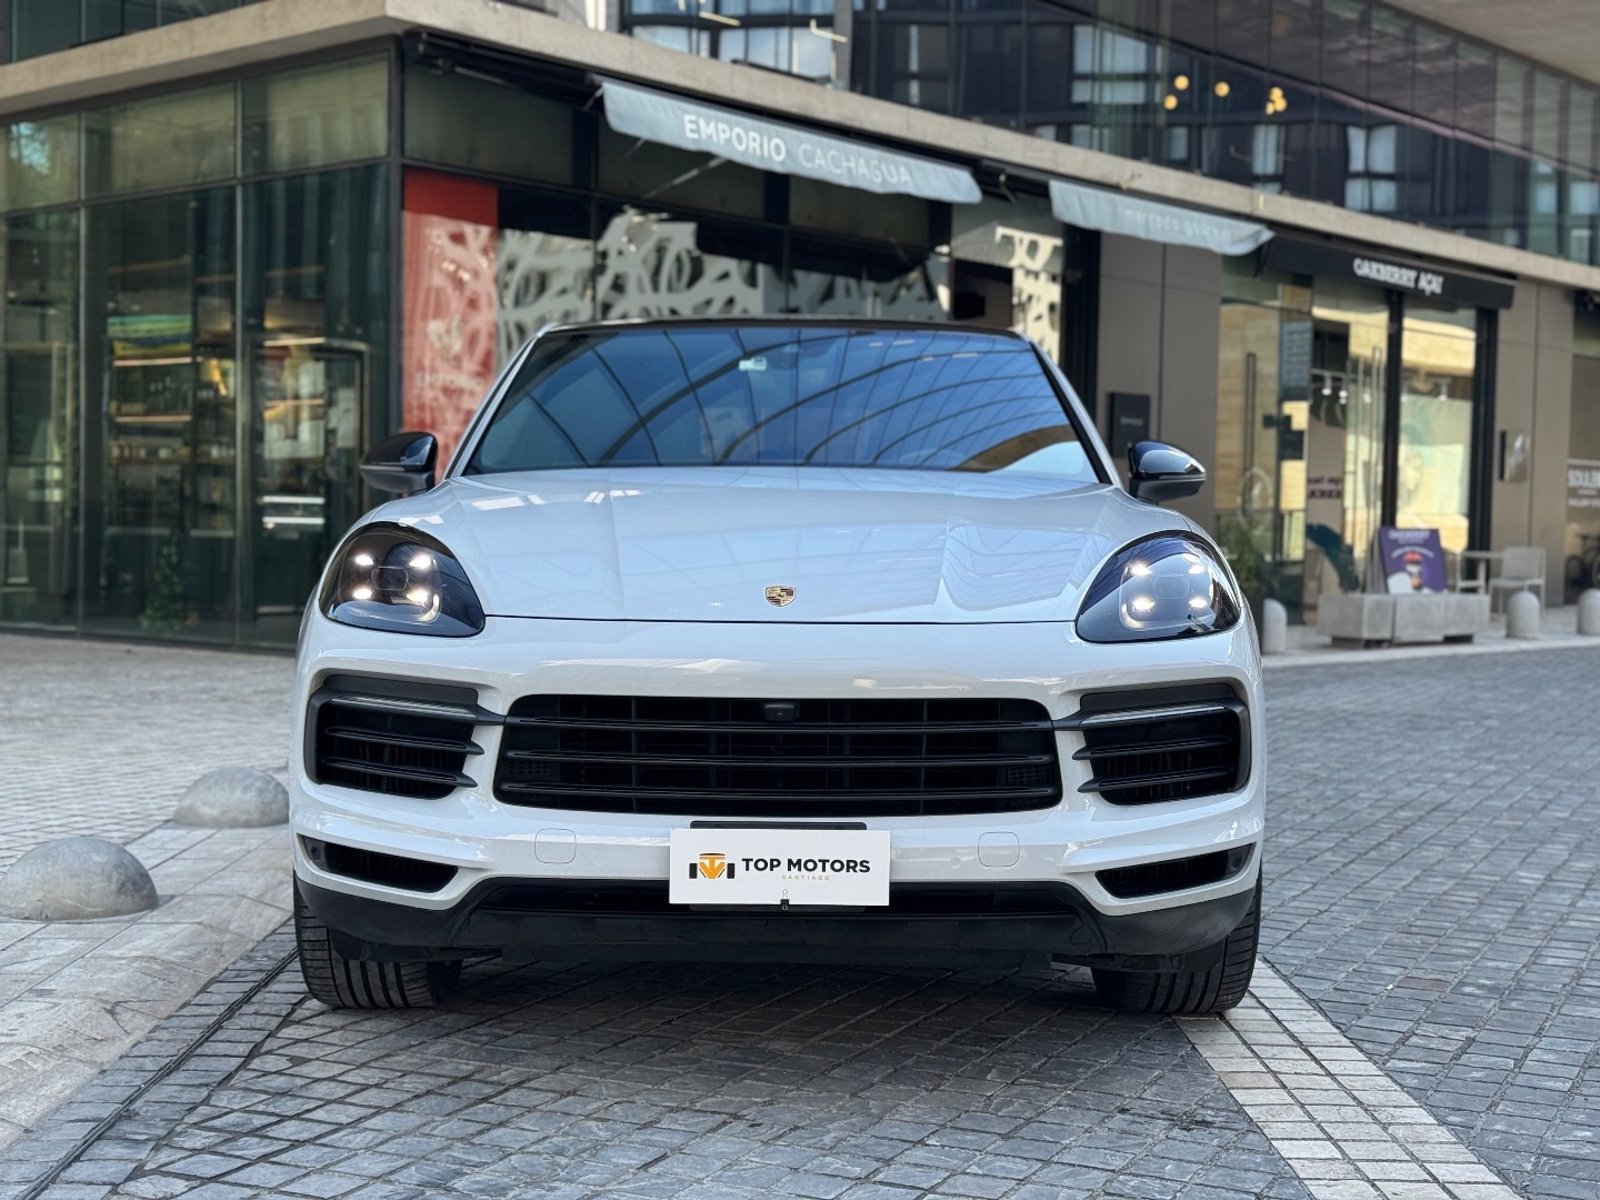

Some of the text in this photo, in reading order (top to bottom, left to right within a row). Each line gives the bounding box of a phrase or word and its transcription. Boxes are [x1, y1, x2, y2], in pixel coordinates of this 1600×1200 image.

[684, 113, 787, 162] EMPORIO
[741, 857, 871, 874] TOP MOTORS
[781, 874, 831, 882] SANTIAGO
